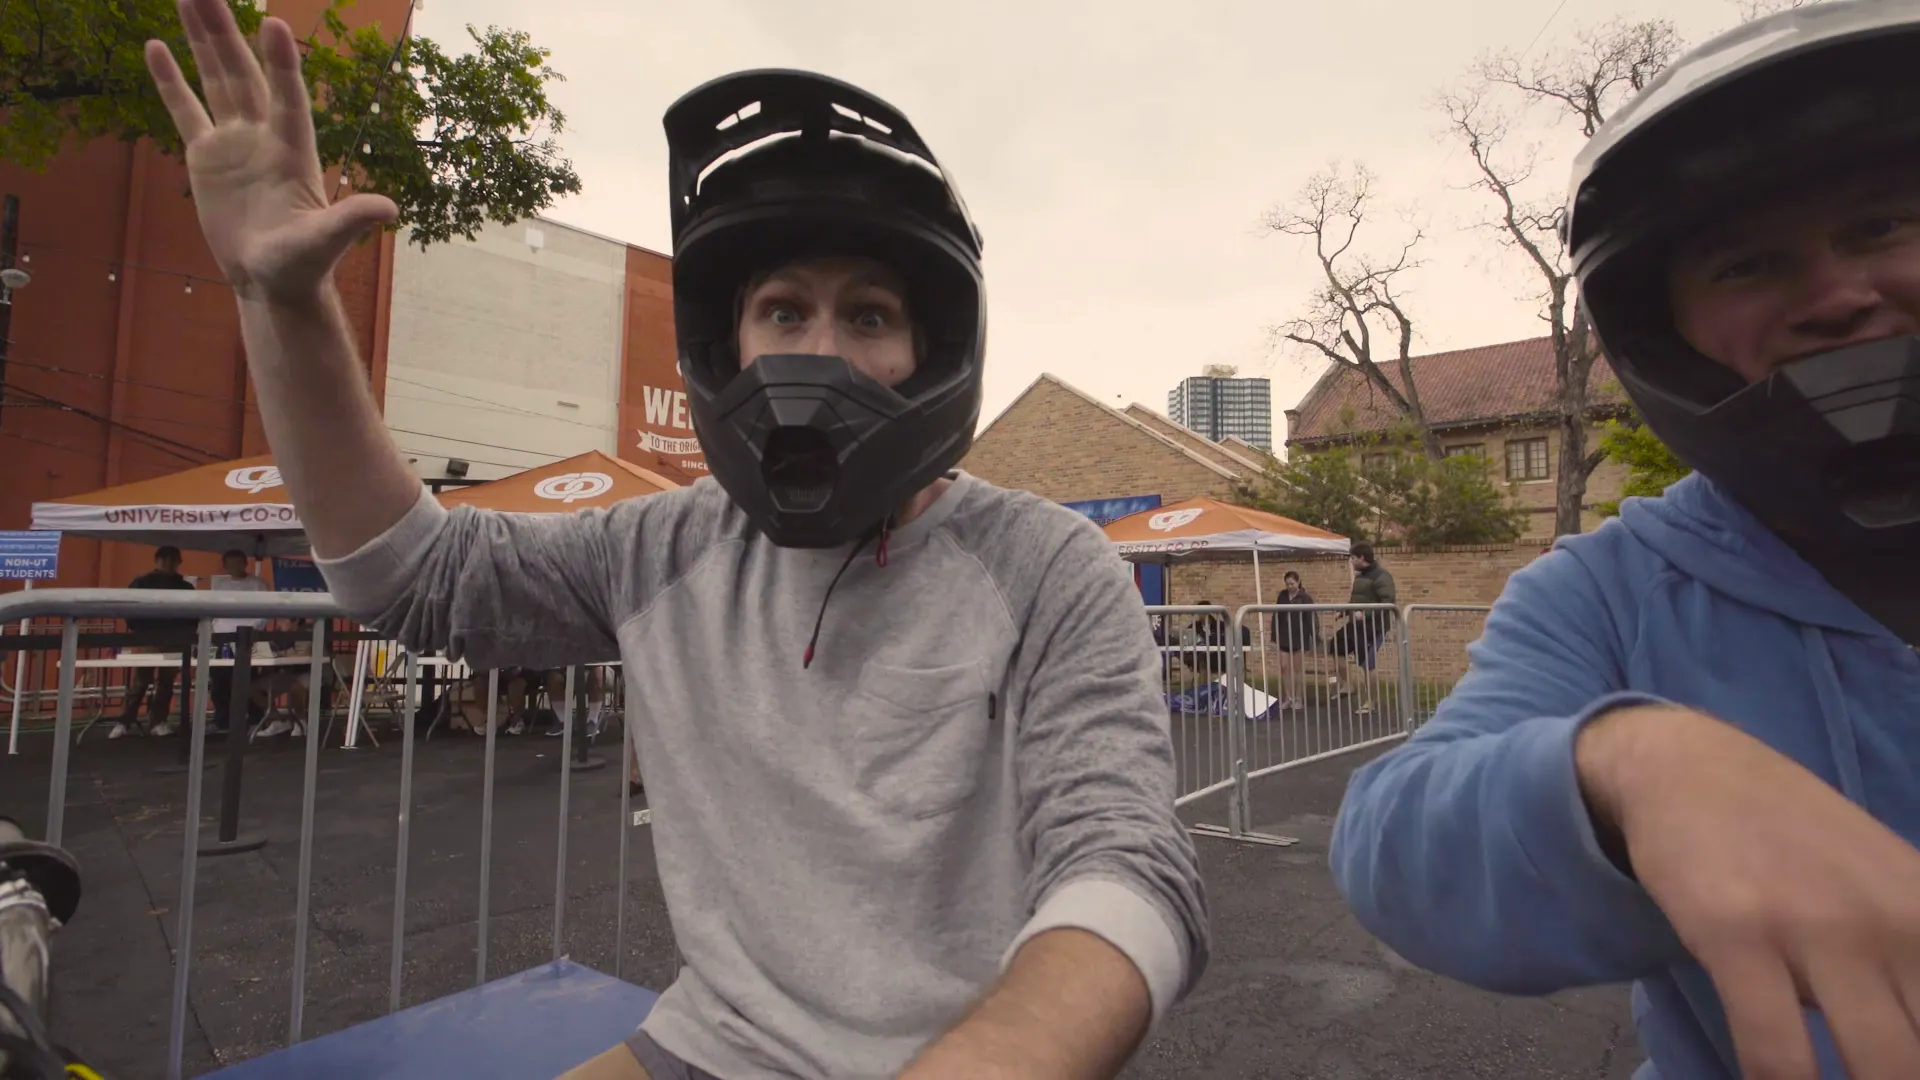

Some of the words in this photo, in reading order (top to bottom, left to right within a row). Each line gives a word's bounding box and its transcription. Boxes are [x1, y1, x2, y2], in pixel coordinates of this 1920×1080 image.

[650, 435, 660, 449] TO
[663, 440, 677, 453] THE
[105, 508, 230, 524] UNIVERSITY
[1116, 543, 1161, 553] ERSITY
[5, 558, 48, 567] NON-UT
[0, 569, 54, 578] STUDENTS
